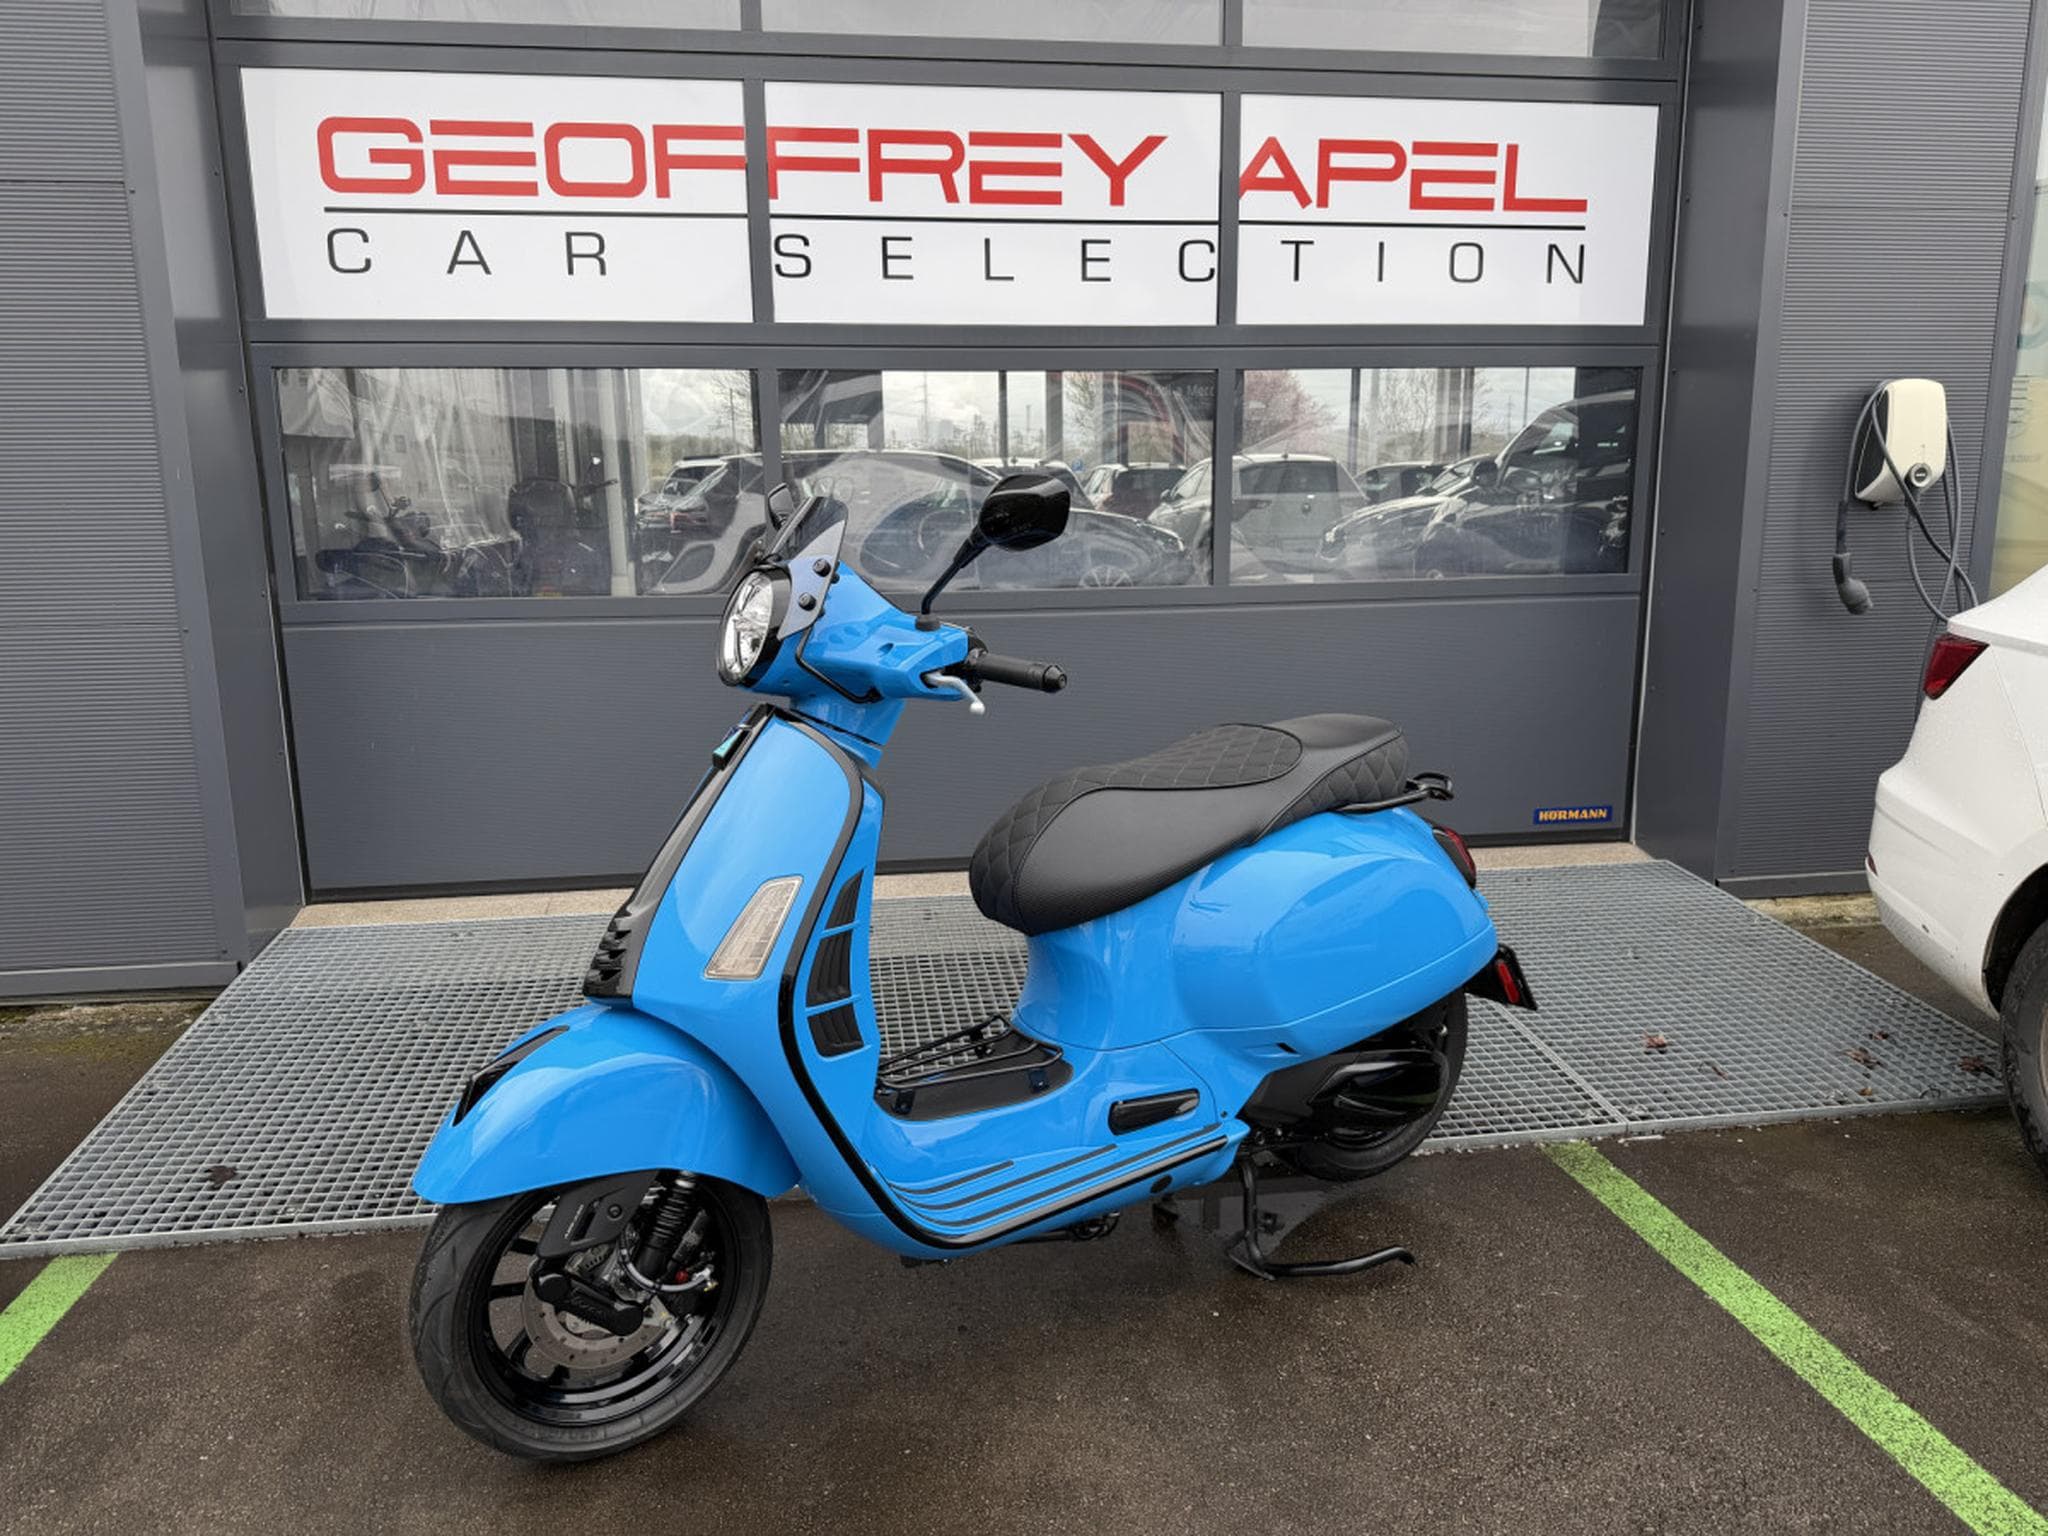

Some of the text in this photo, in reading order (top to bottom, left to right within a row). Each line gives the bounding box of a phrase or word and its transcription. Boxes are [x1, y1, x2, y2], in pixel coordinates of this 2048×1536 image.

[317, 116, 1588, 213] GEOFFREY APEL
[326, 228, 1585, 284] CAR SELECTION
